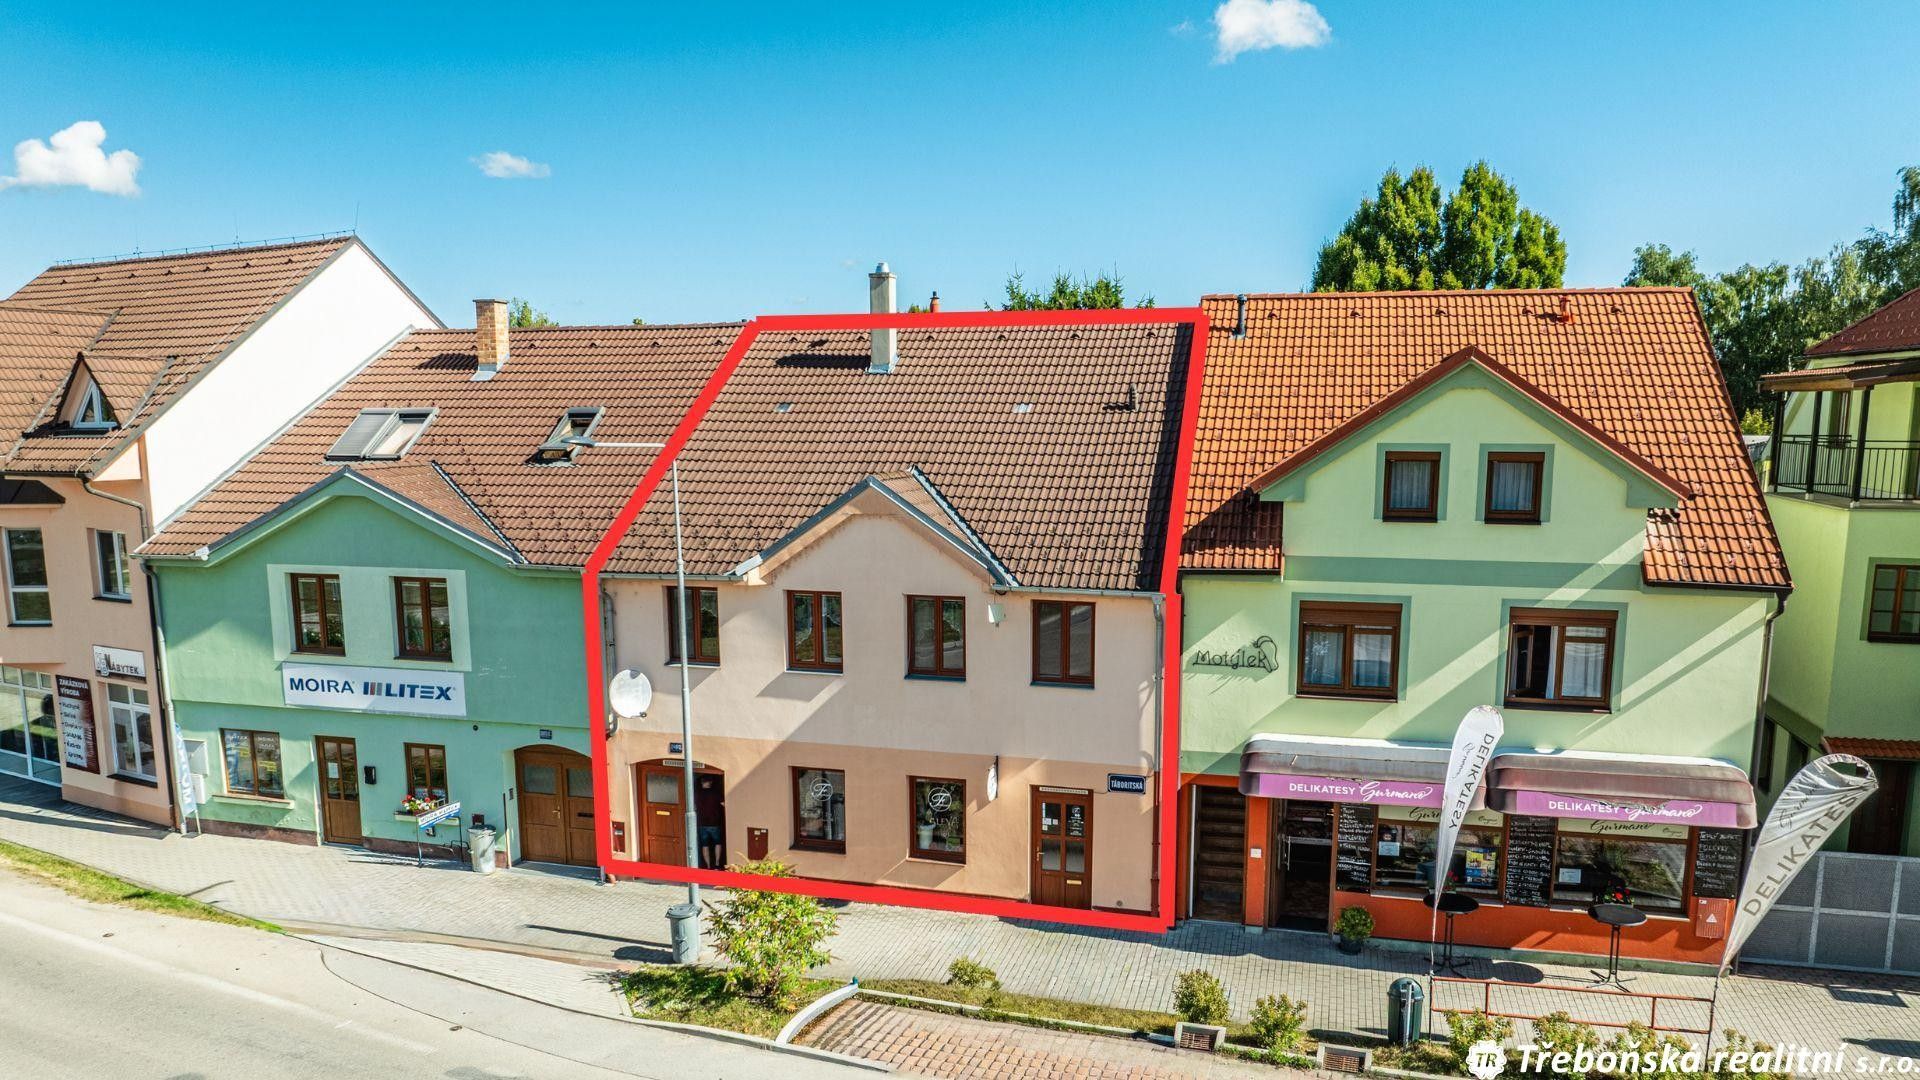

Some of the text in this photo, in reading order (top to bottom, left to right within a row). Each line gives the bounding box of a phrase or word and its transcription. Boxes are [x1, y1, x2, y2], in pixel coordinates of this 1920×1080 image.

[1196, 649, 1268, 670] Motýlek
[289, 677, 452, 701] MOIRA LITEX
[1111, 780, 1143, 790] TÁBORITSKÁ
[1289, 780, 1434, 801] DELIKATESY Gurmano
[1549, 801, 1621, 814] DELIKATESY
[1743, 794, 1858, 917] DELIKATES
